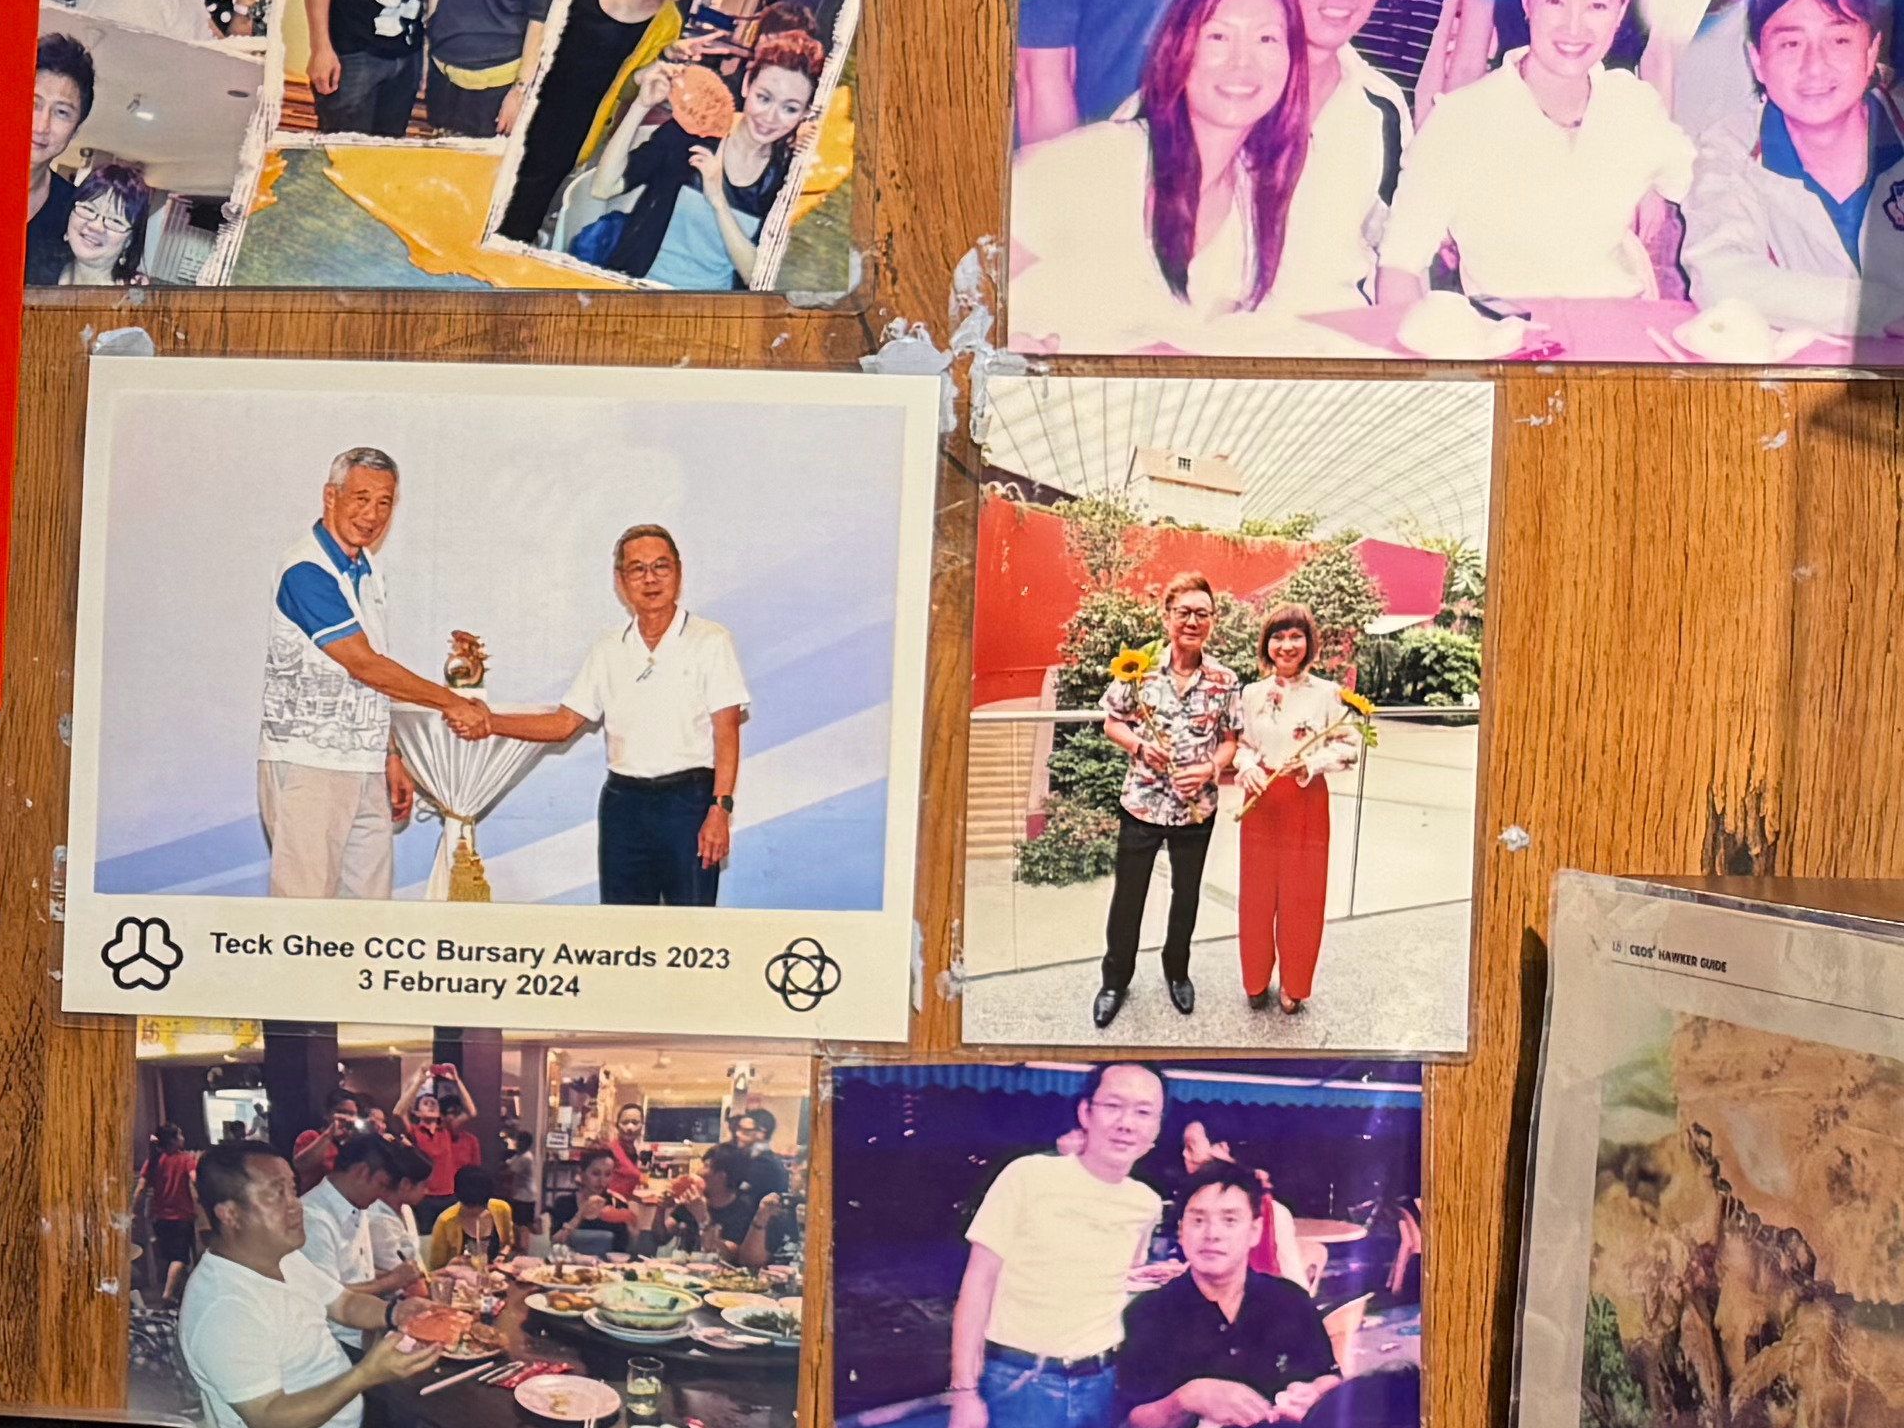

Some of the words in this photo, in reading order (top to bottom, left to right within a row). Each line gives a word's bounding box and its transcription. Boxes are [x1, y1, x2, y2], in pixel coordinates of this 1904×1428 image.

[210, 932, 273, 956] Teck
[283, 934, 355, 959] Ghee
[364, 937, 426, 961] CCC
[436, 939, 545, 971] Bursary
[553, 943, 658, 969] Awards
[666, 946, 732, 971] 2023
[1658, 950, 1698, 967] HAWKER
[1700, 957, 1728, 973] GUIDE
[357, 968, 374, 991] 3
[383, 970, 507, 1001] February
[515, 974, 581, 998] 2024
